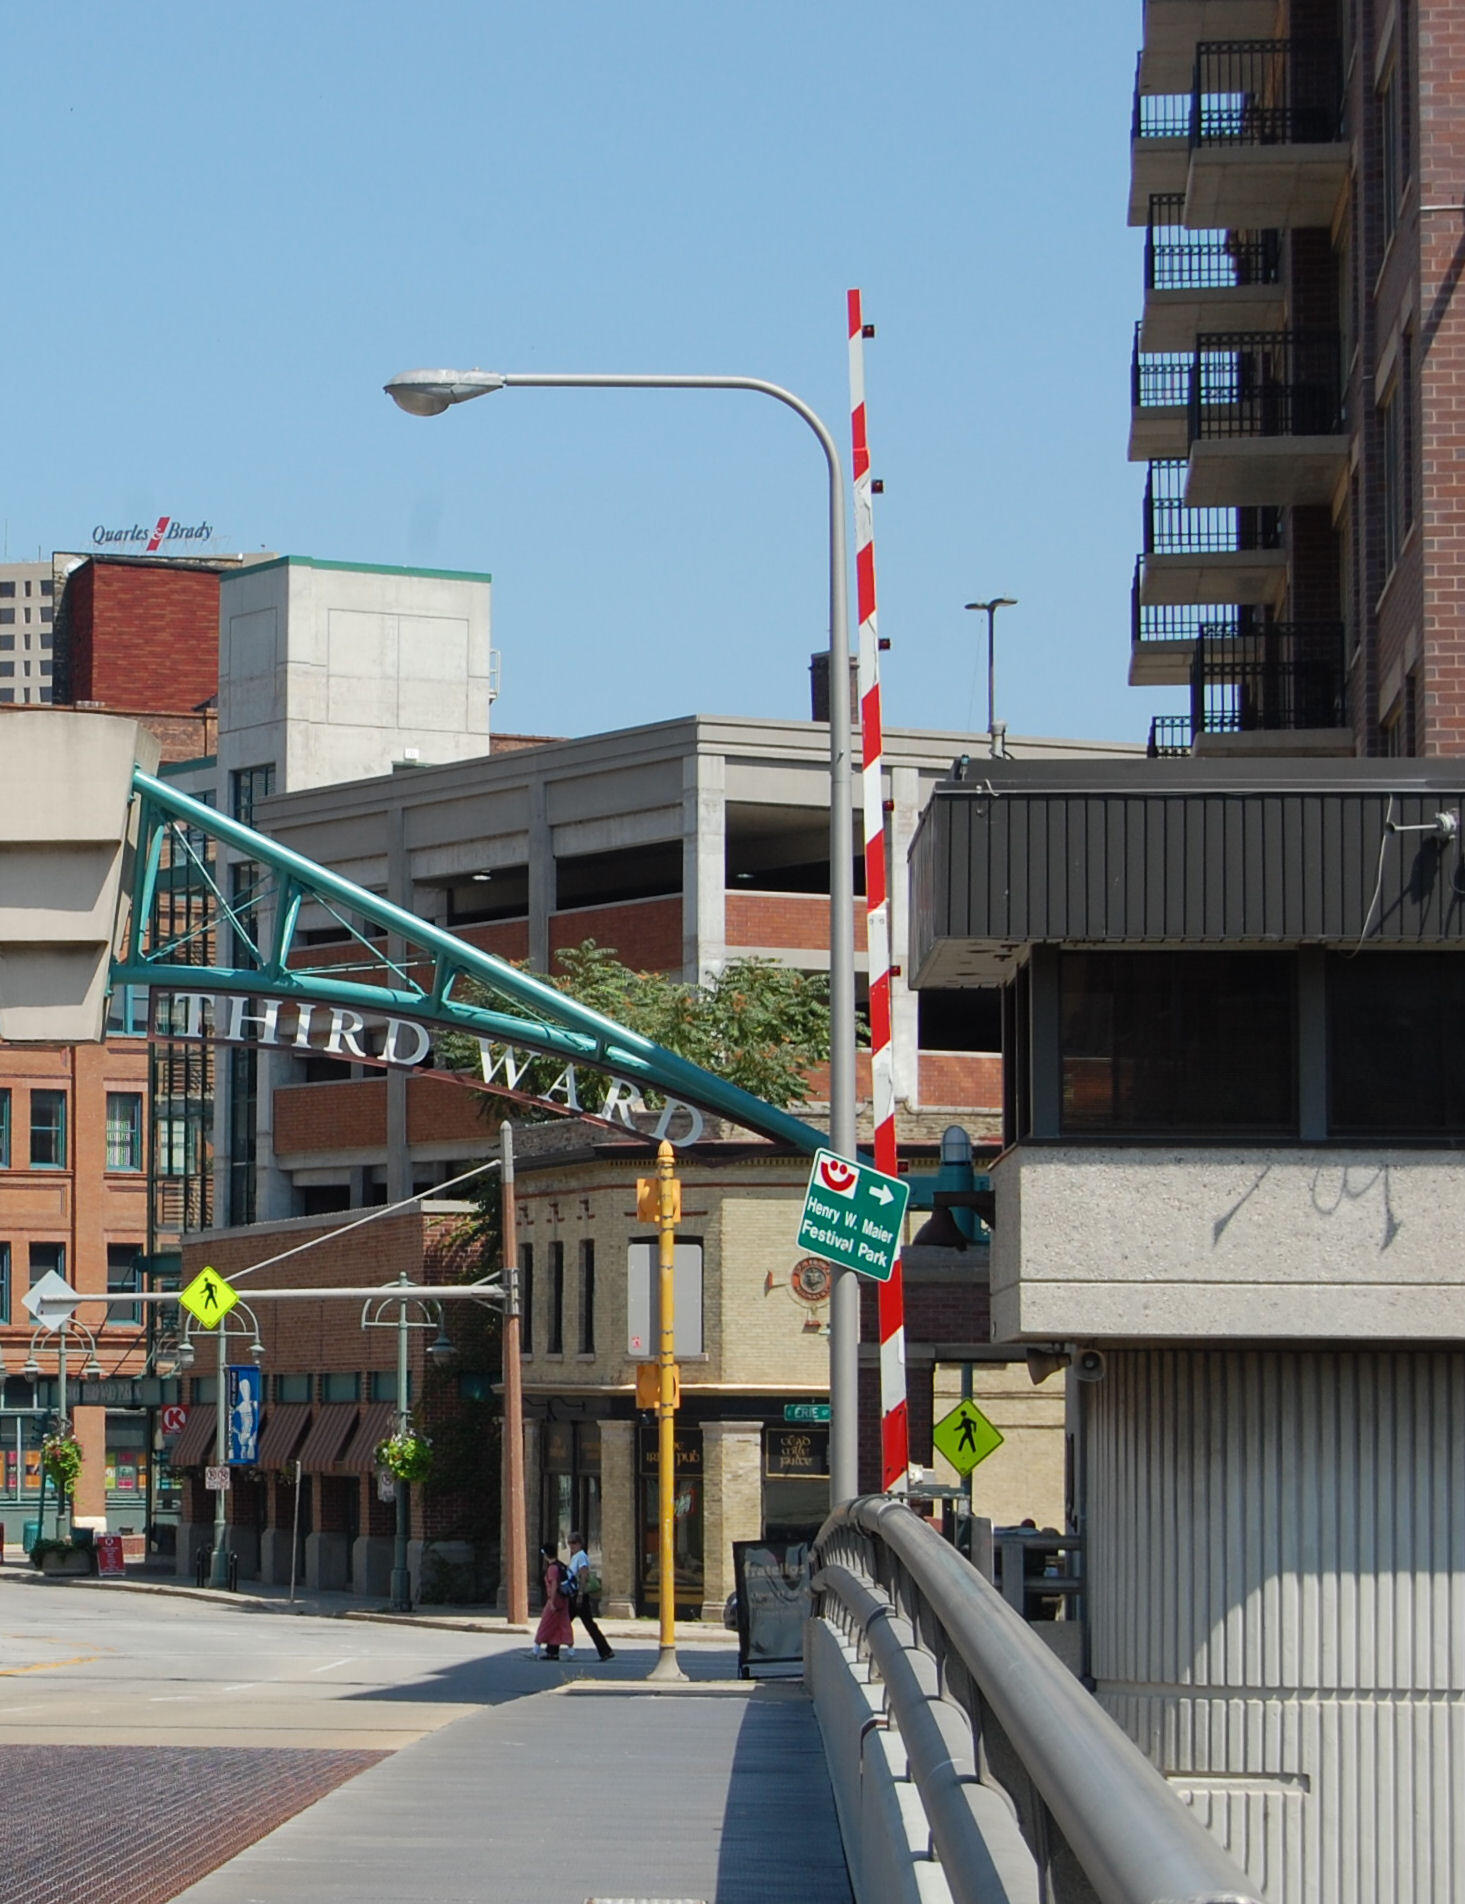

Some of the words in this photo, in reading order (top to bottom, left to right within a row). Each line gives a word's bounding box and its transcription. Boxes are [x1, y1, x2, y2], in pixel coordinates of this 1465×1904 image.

[93, 524, 149, 545] Quarles
[152, 527, 163, 541] &
[166, 520, 213, 541] Brady
[173, 992, 431, 1066] THIRD
[476, 1037, 704, 1148] WARD
[801, 1219, 854, 1253] Festival
[857, 1242, 888, 1268] Park
[806, 1196, 840, 1224] Henry
[844, 1210, 858, 1231] W.
[861, 1218, 893, 1244] Maier
[794, 1406, 819, 1419] ERIE
